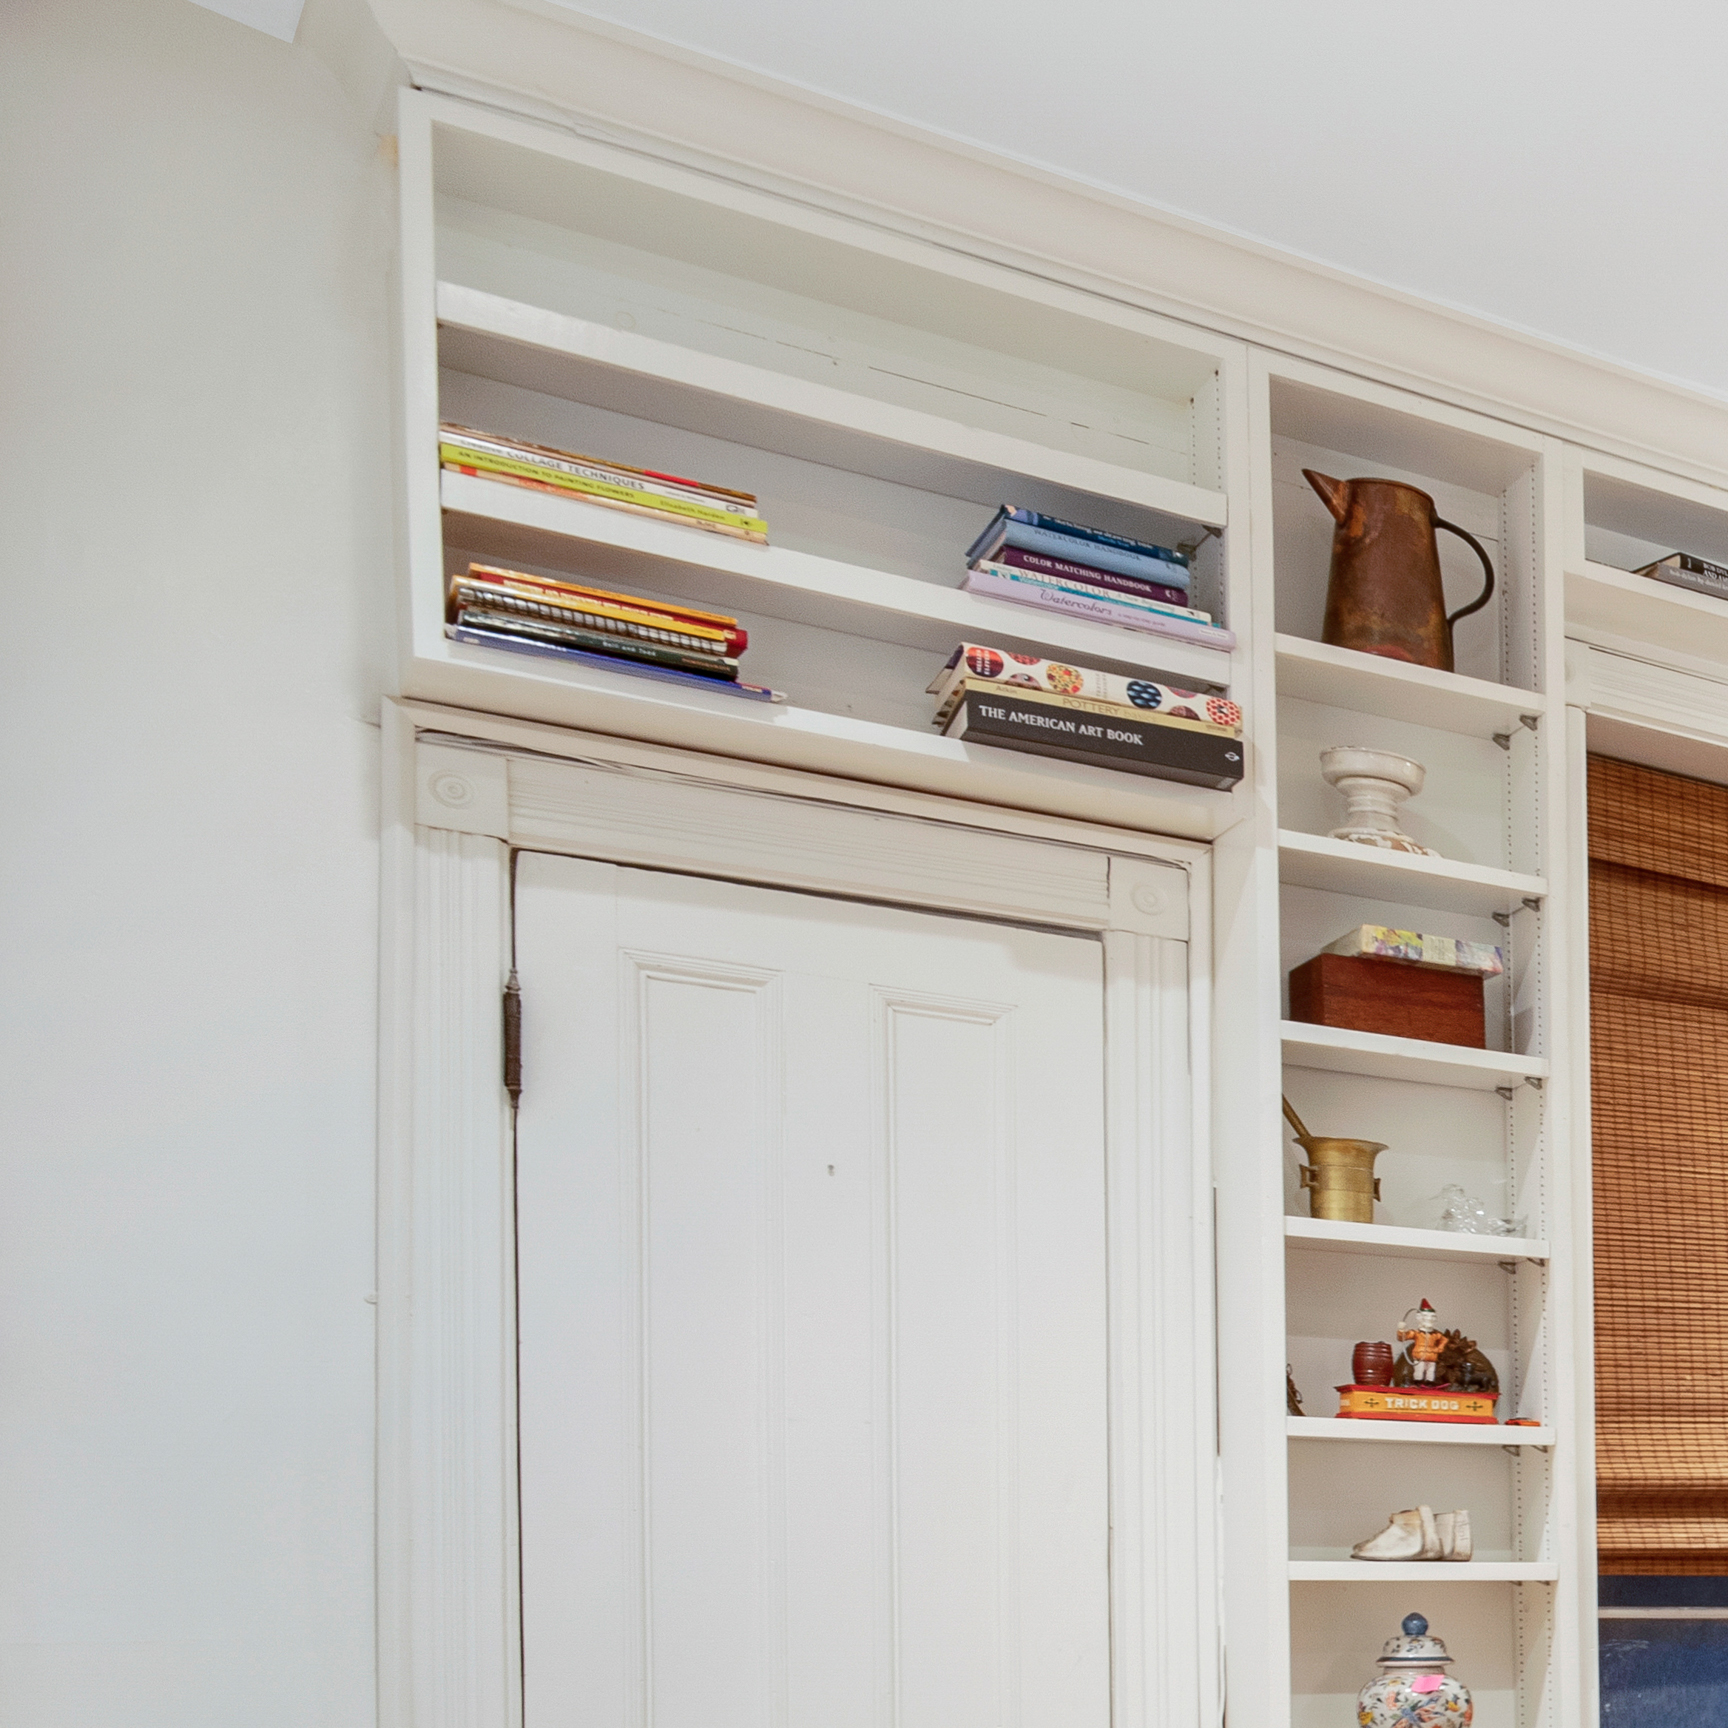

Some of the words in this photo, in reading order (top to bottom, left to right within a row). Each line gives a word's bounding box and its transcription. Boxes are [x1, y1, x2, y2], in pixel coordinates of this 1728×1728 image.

[507, 451, 562, 470] COLLAGE
[567, 465, 644, 491] TECHNIQUES
[1023, 555, 1053, 568] COLOR
[1054, 562, 1102, 581] MATCHING
[1104, 573, 1153, 592] HANDBOOK
[1040, 588, 1112, 616] Watercolors
[1062, 698, 1120, 716] POTTERY
[979, 705, 1006, 721] THE
[1008, 711, 1075, 733] AMERICAN
[1078, 721, 1103, 738] ART
[1106, 729, 1143, 746] BOOK
[1385, 1397, 1428, 1409] TRICK
[1431, 1400, 1459, 1410] DOG
